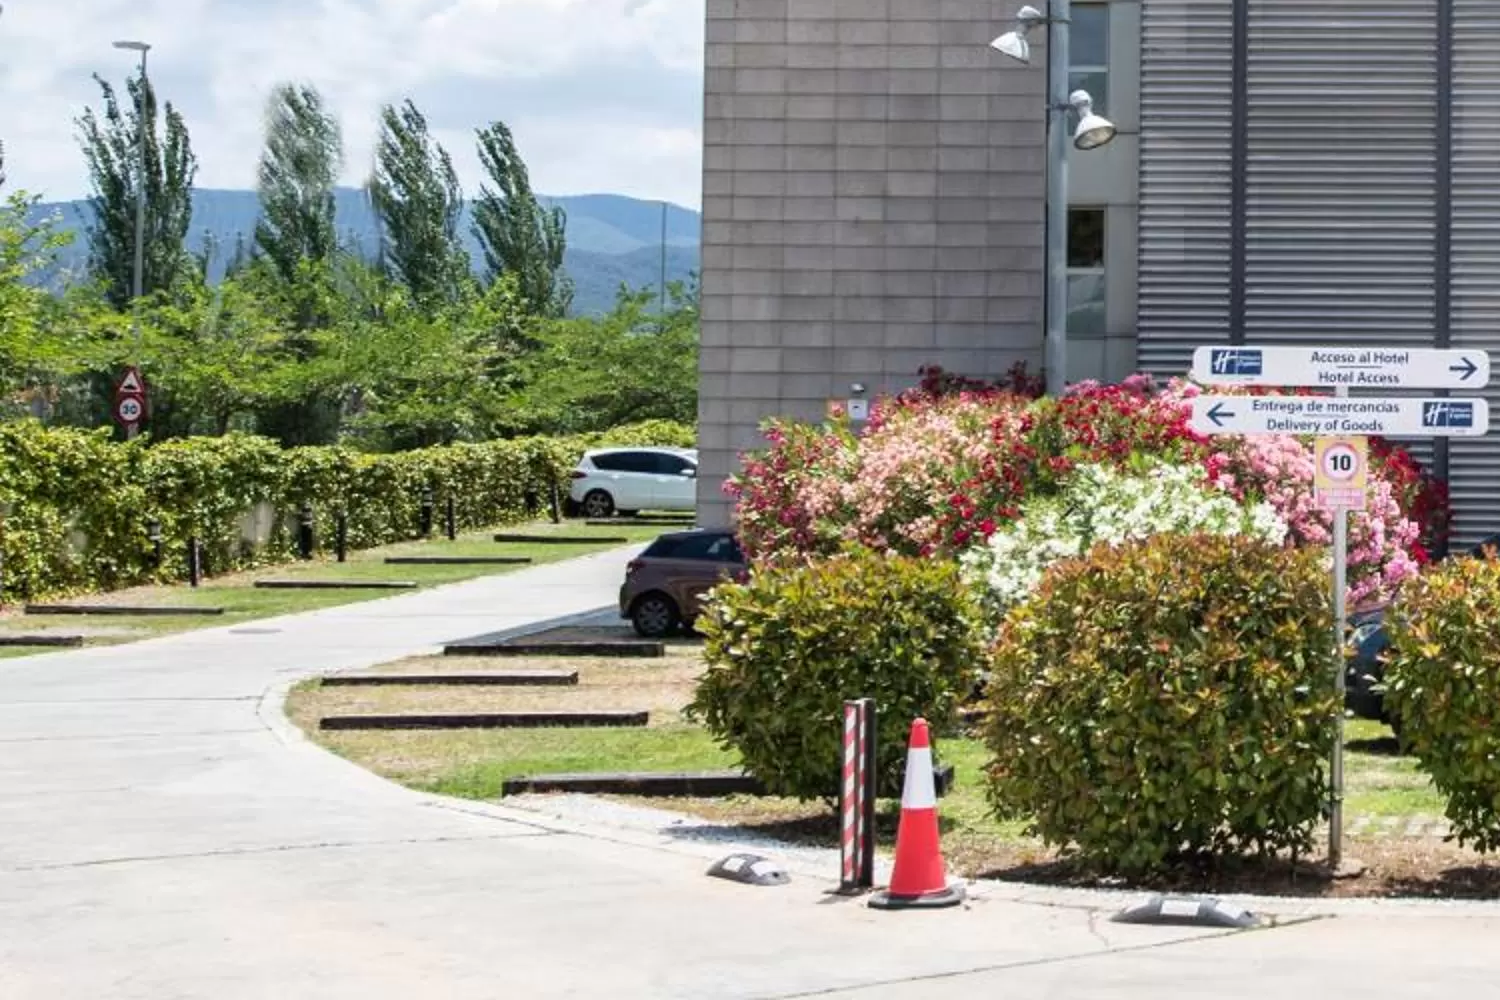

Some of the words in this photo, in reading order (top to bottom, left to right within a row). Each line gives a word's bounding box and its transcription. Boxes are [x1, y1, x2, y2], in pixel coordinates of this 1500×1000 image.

[1311, 351, 1356, 363] Acceso
[1360, 351, 1371, 363] al
[1374, 351, 1409, 364] Hotel
[1319, 371, 1353, 383] Hotel
[1357, 371, 1399, 384] Access
[1252, 400, 1303, 414] Entrega
[1307, 400, 1323, 412] de
[1267, 418, 1320, 432] Delivery
[1324, 418, 1339, 431] of
[1341, 419, 1383, 431] Goods
[1330, 455, 1351, 471] 10
